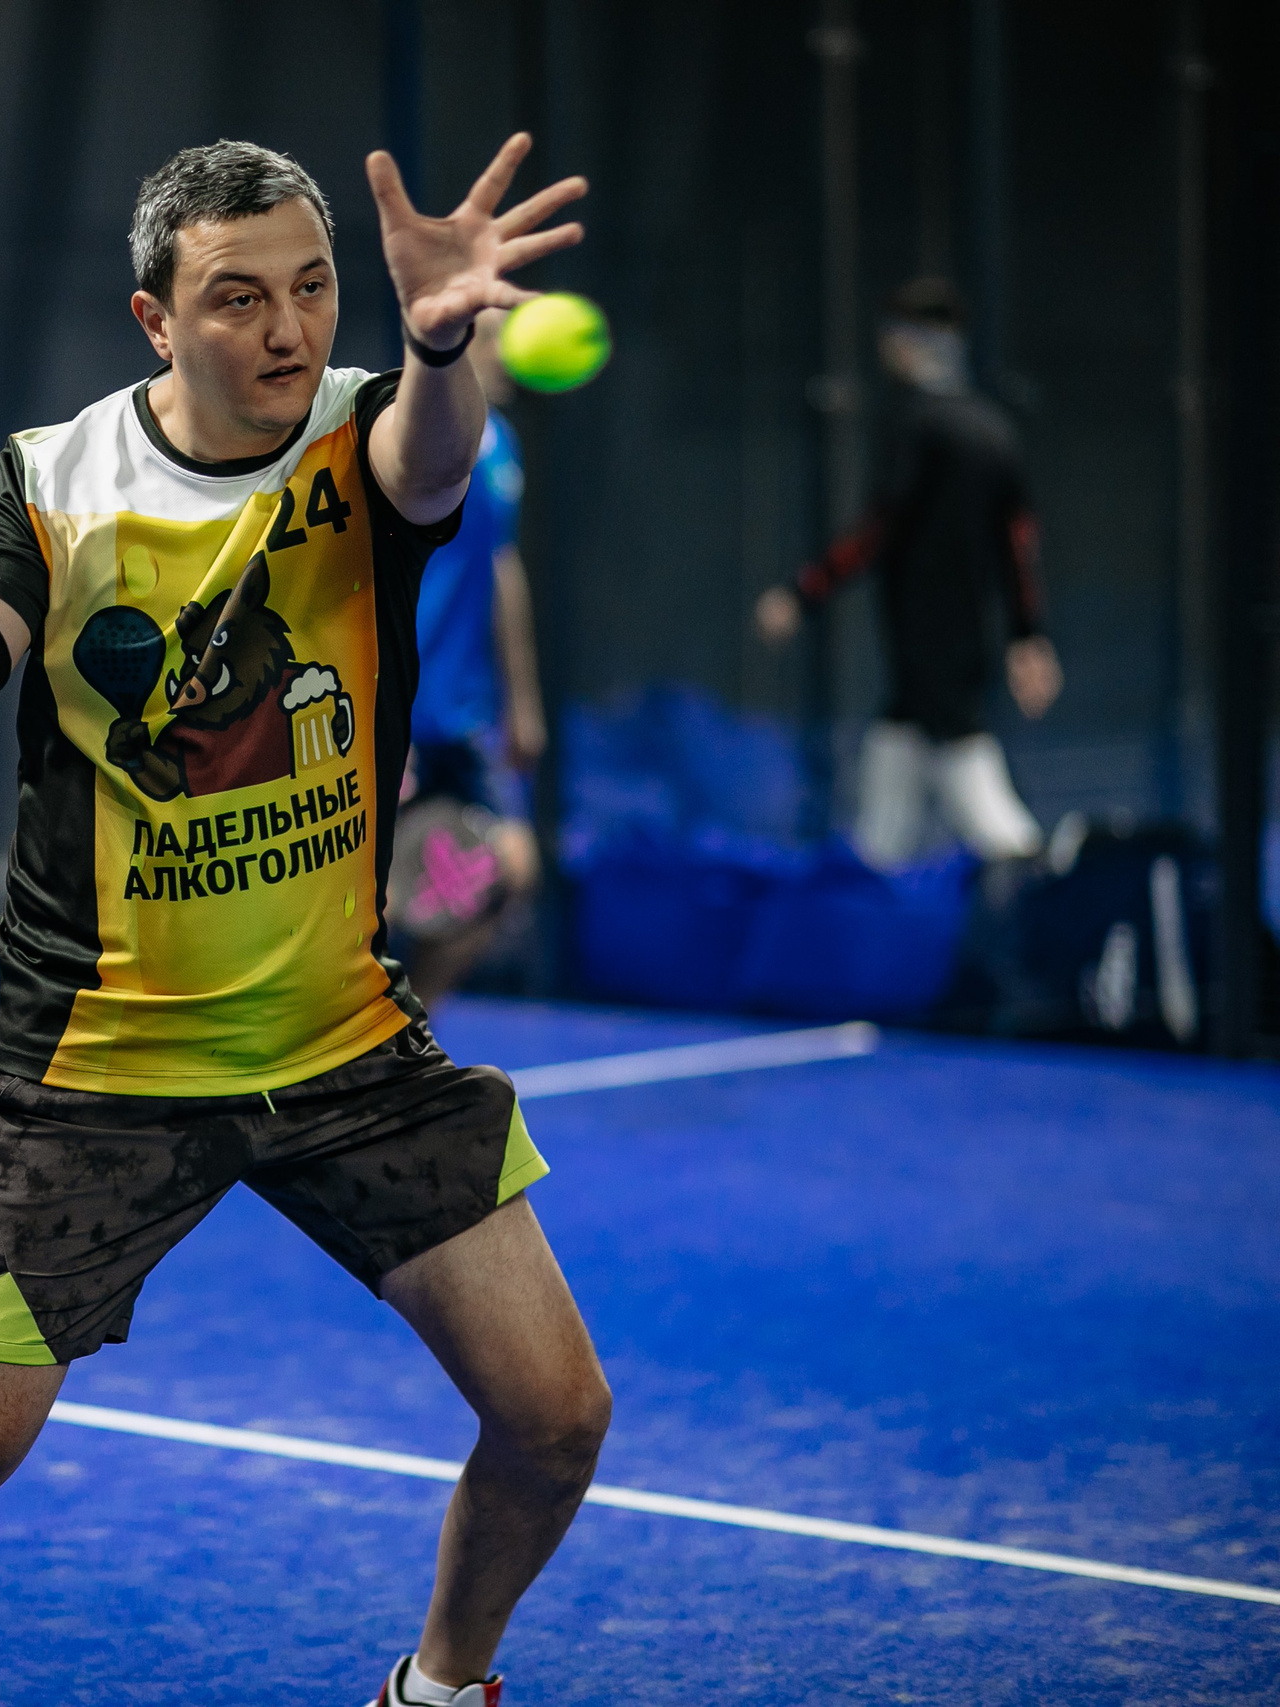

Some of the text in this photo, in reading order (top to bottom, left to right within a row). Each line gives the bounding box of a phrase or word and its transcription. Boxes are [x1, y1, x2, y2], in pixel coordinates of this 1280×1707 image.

[265, 467, 352, 553] 24
[124, 809, 367, 901] АЛКОГОЛИКИ
[132, 768, 361, 863] ПАДЕЛЬНЫЕ
